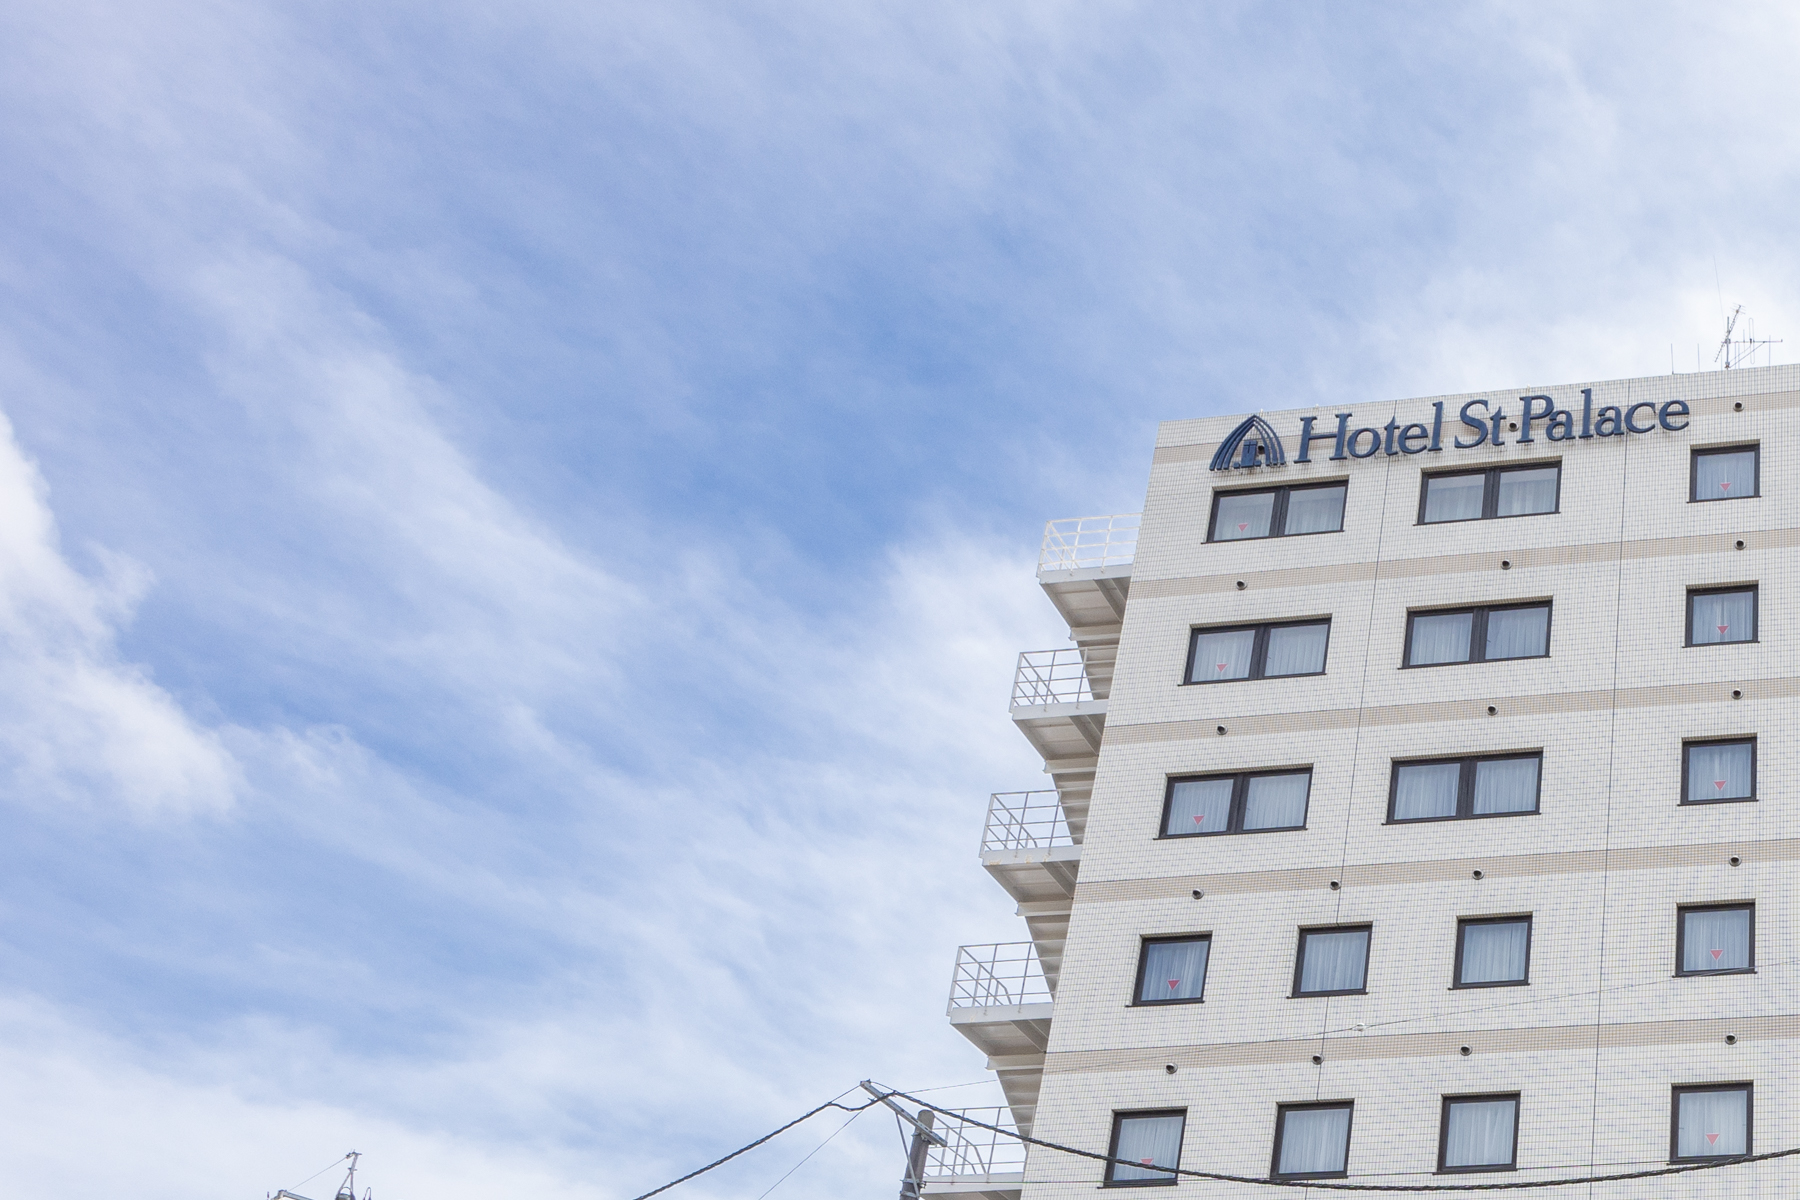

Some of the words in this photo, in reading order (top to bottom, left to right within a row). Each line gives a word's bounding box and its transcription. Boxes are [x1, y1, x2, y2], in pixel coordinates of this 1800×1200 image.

[1293, 401, 1443, 464] Hotel
[1454, 398, 1505, 449] St
[1516, 388, 1691, 445] Palace
